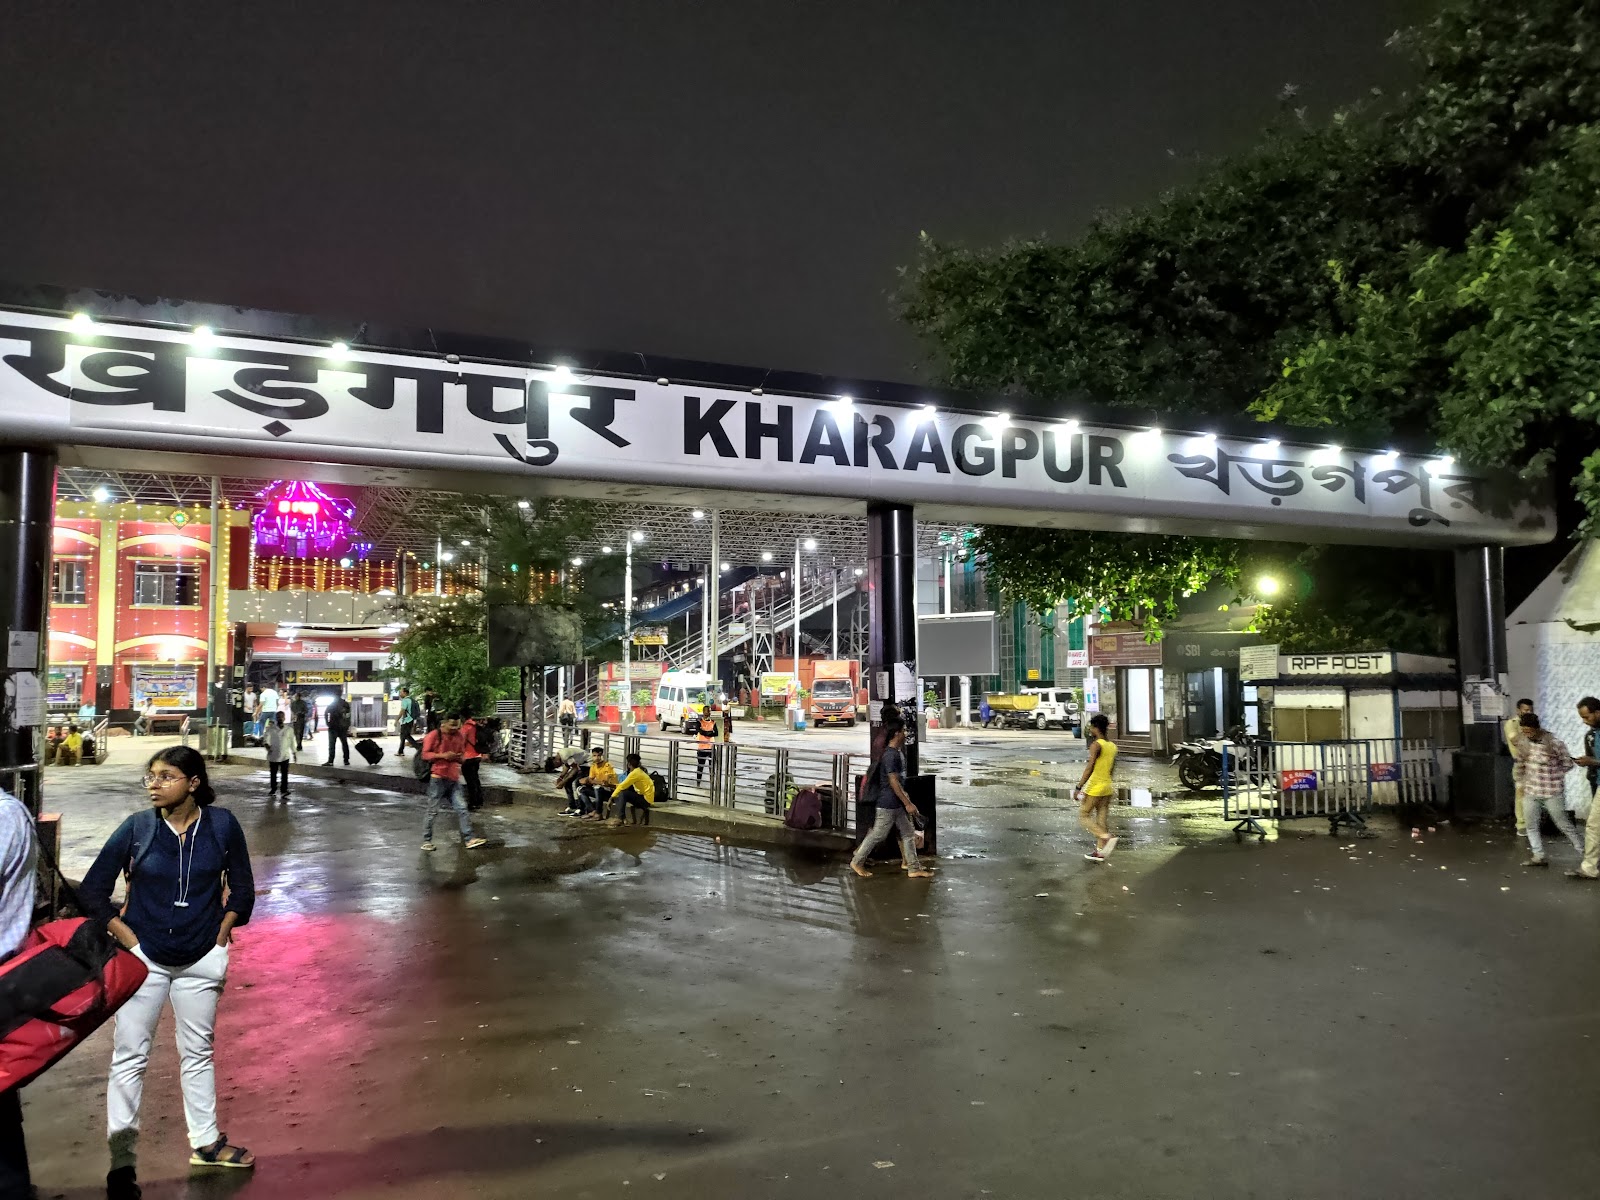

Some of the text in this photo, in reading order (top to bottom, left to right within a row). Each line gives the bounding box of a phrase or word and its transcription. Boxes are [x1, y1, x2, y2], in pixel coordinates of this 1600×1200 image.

[0, 325, 636, 467] खड़गपुर
[683, 396, 1128, 488] KHARAGPUR
[1185, 644, 1201, 656] SBI
[1292, 655, 1383, 670] RPF POST
